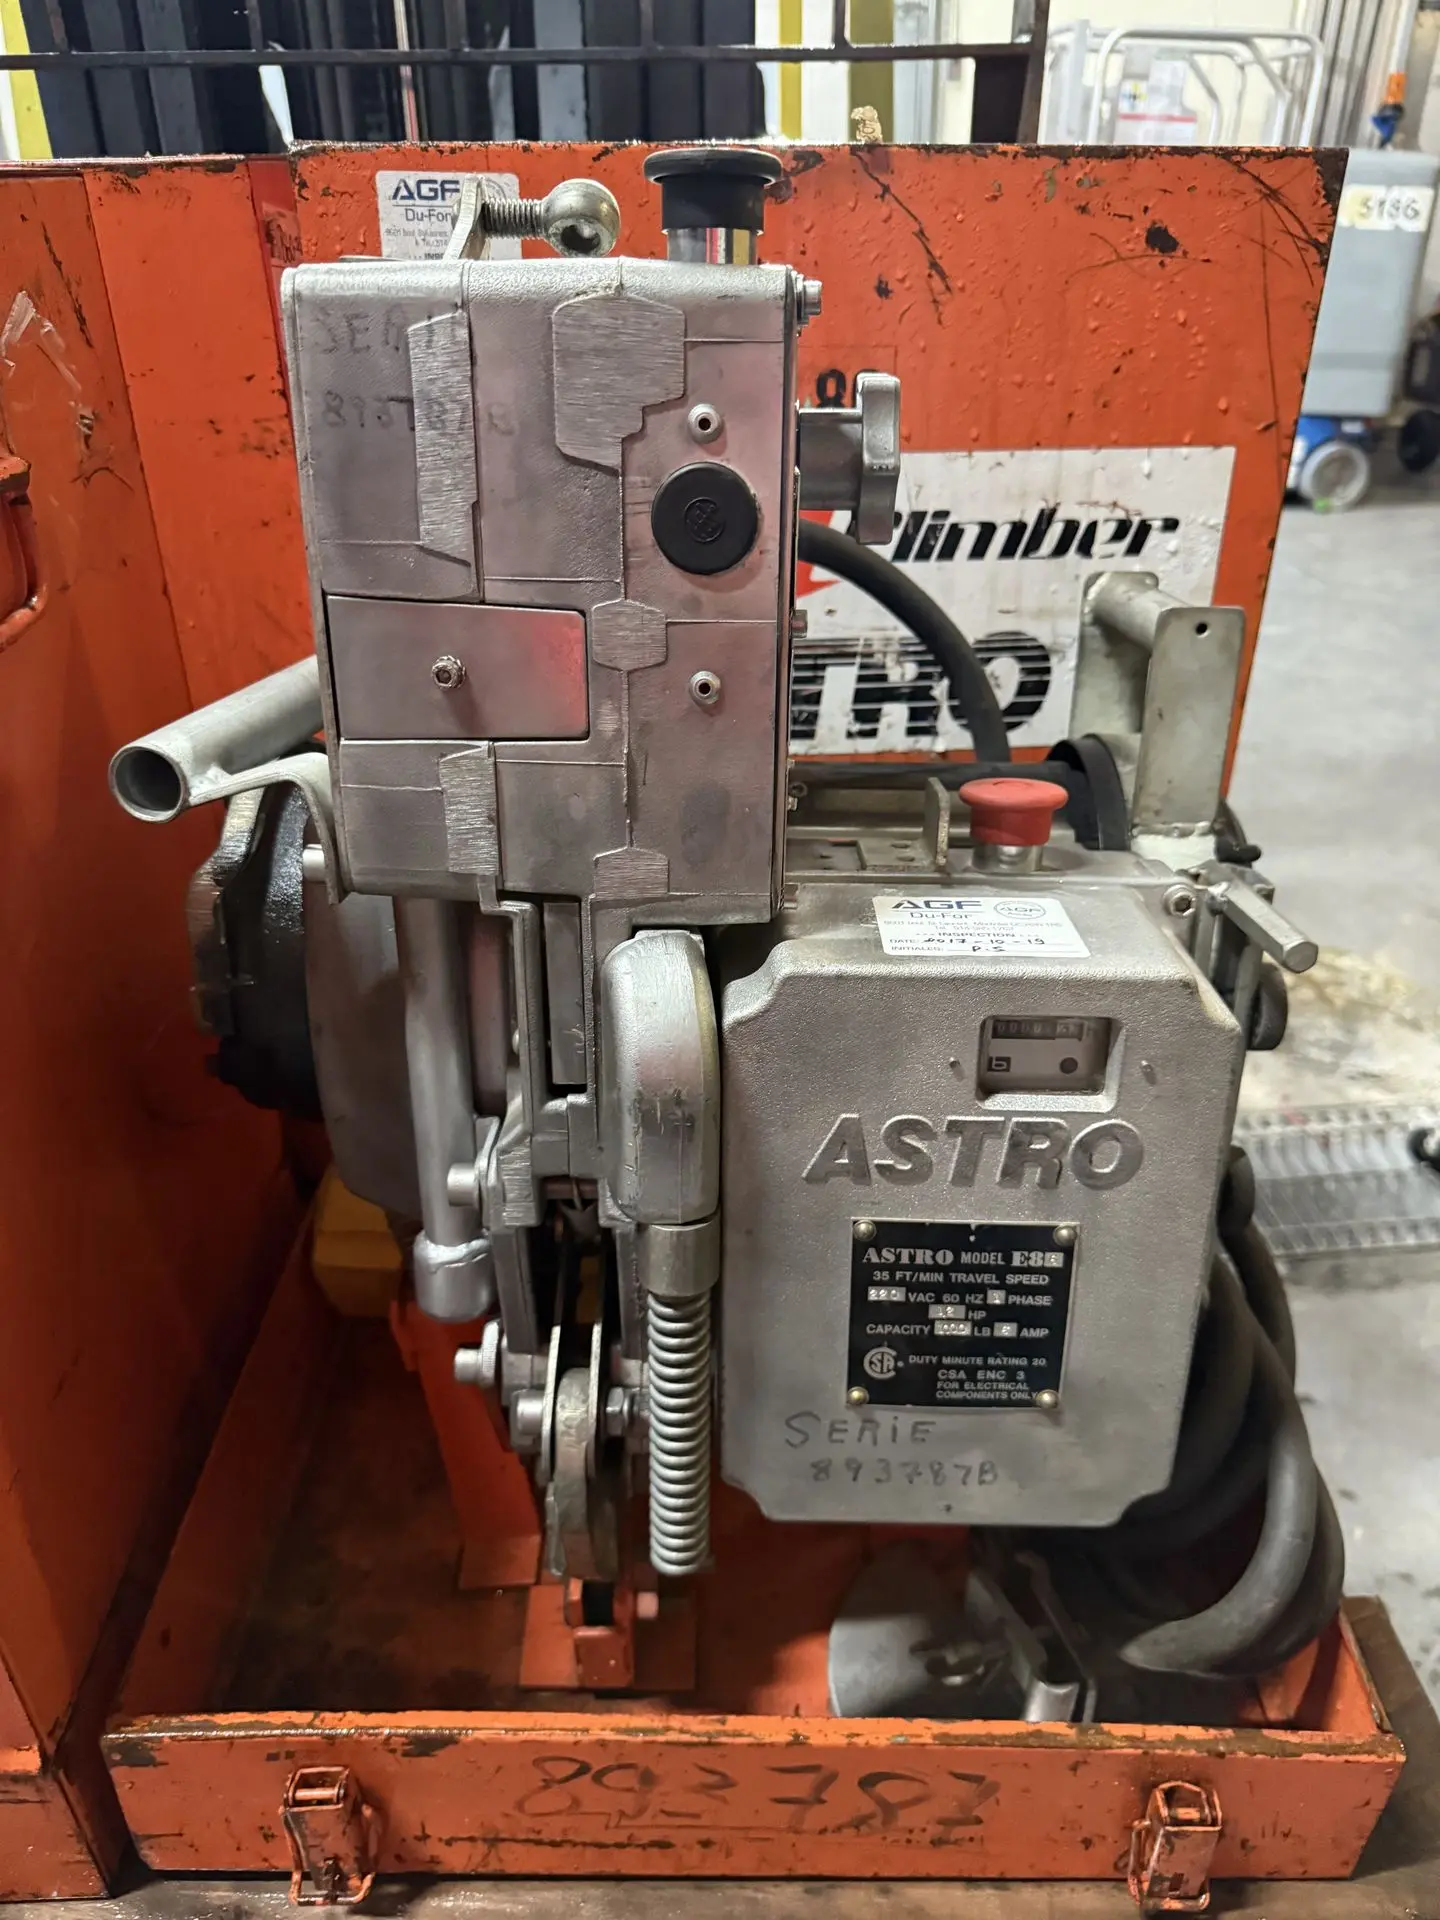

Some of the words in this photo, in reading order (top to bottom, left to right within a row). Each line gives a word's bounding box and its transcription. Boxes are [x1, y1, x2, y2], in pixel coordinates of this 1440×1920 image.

[391, 178, 460, 201] AGF
[891, 899, 982, 910] AGF
[800, 1112, 1144, 1190] ASTRO
[862, 1246, 954, 1266] ASTRO
[960, 1251, 1006, 1265] MODEL
[872, 1270, 890, 1282] 35
[895, 1272, 944, 1283] FT/MIN
[949, 1272, 1000, 1284] TRAVEL
[1005, 1274, 1049, 1285] SPEED
[908, 1292, 935, 1303] VAC
[942, 1293, 960, 1303] 60
[965, 1294, 984, 1304] HZ
[1007, 1294, 1052, 1306] PHASE
[968, 1310, 987, 1320] HP
[865, 1323, 931, 1335] CAPACITY
[973, 1326, 991, 1337] LB
[1019, 1327, 1050, 1338] AMP
[908, 1354, 938, 1364] DUTY
[942, 1355, 983, 1366] MINUTE
[987, 1356, 1028, 1366] RATING
[937, 1369, 967, 1380] CSA
[976, 1369, 1007, 1380] ENC
[1015, 1370, 1026, 1380] 3
[936, 1380, 960, 1390] FOR
[963, 1381, 1030, 1391] ELECTRICAL
[935, 1390, 1008, 1399] COMPONENTS
[1010, 1390, 1038, 1400] ONLY
